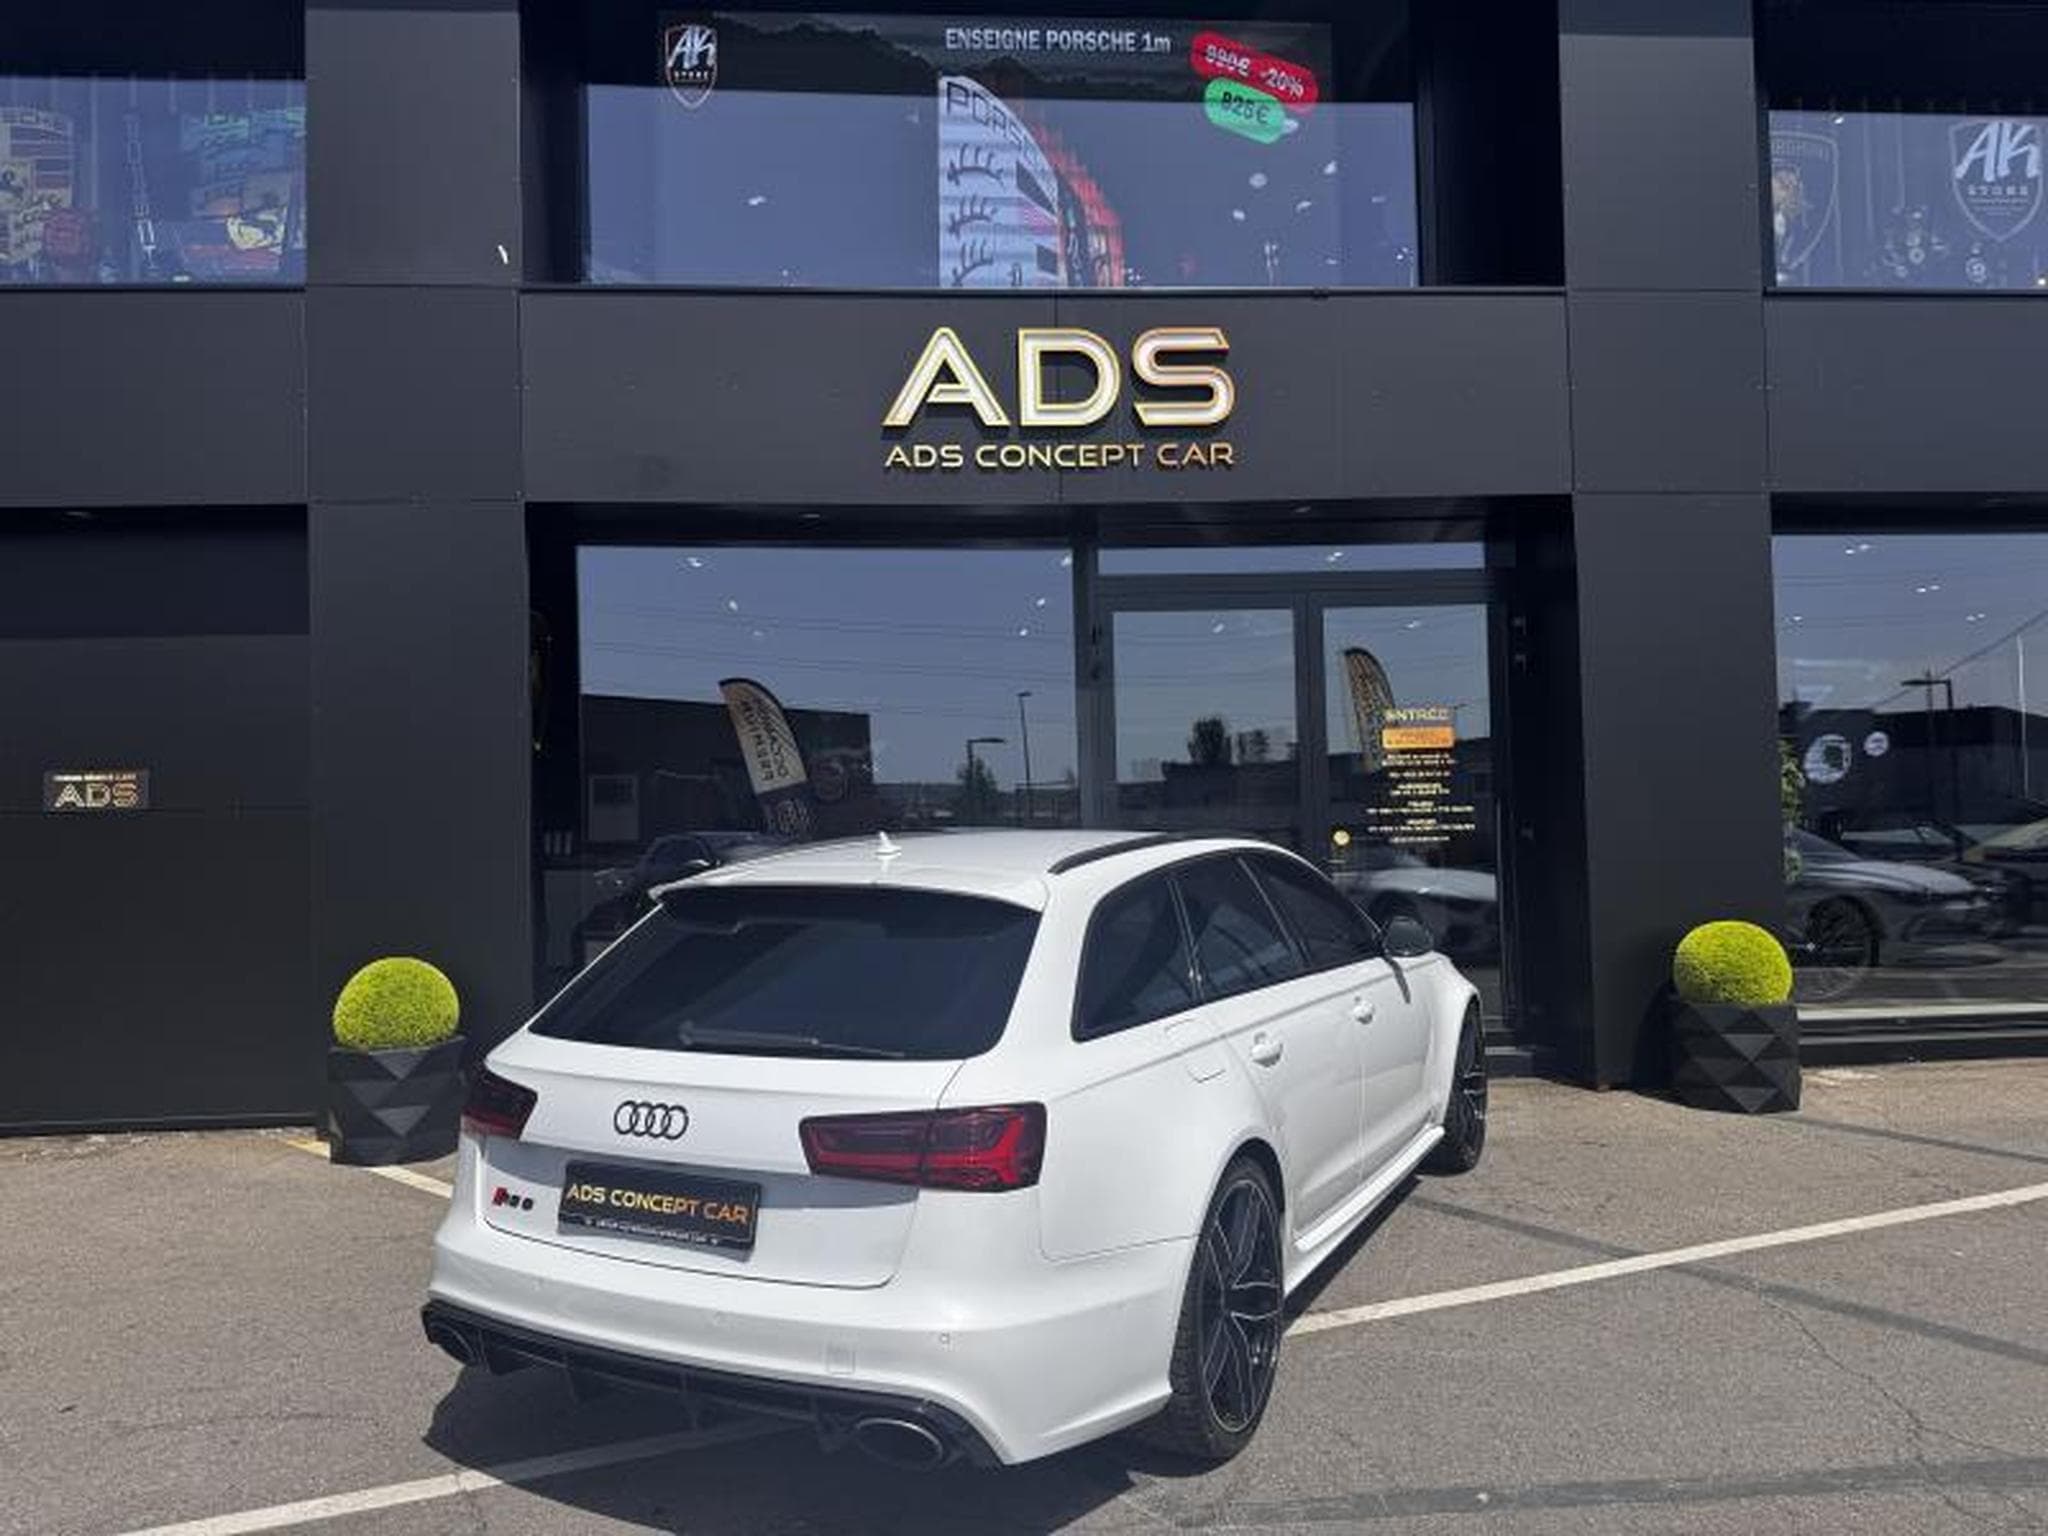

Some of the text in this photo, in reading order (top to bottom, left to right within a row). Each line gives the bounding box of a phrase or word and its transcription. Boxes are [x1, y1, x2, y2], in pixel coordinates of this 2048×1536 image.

[946, 28, 1172, 52] ENSEIGNE PORSCHE 1m
[1955, 121, 2042, 182] AK
[883, 327, 1236, 427] ADS
[885, 443, 1236, 468] ADS CONCEPT CAR
[55, 783, 138, 808] ADS
[566, 1183, 748, 1224] ADS CONCEPT CAR
